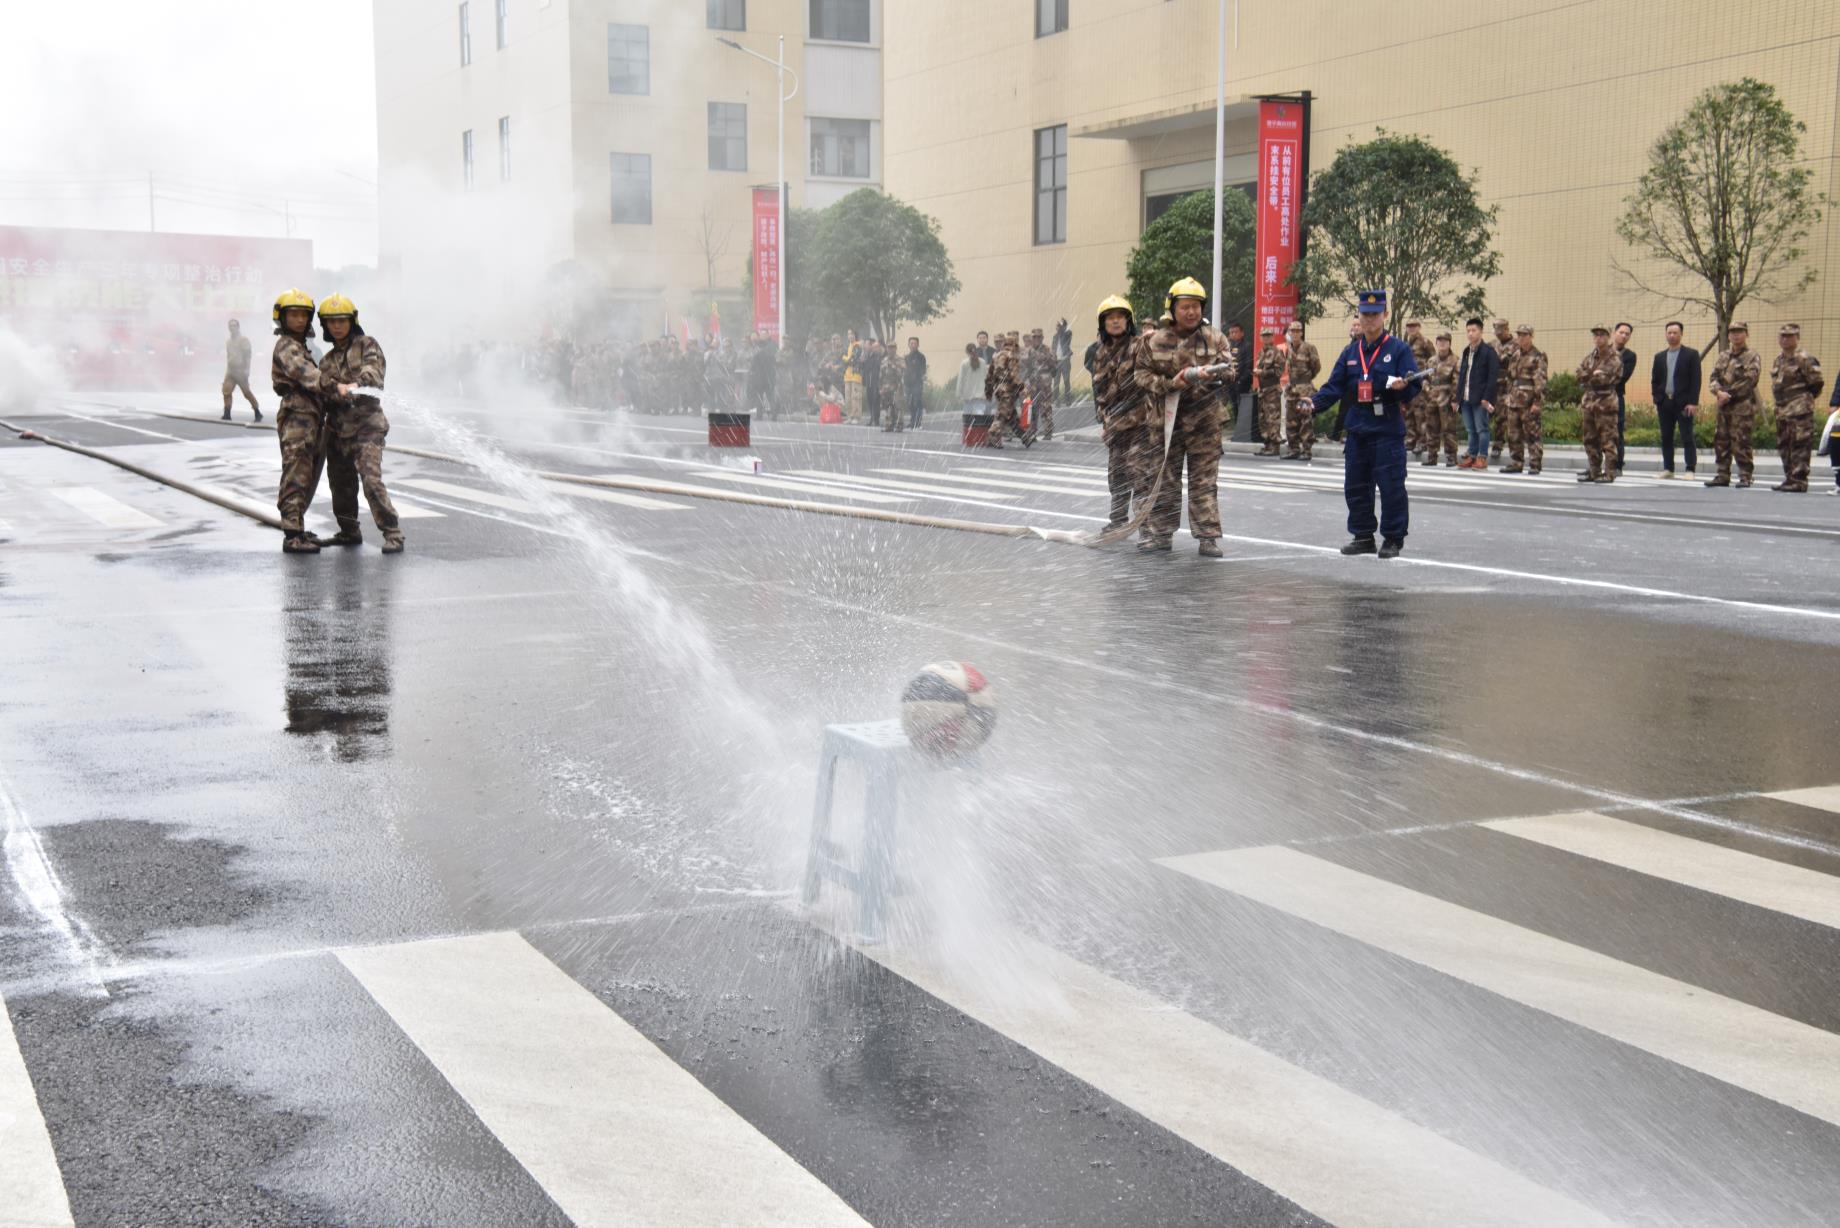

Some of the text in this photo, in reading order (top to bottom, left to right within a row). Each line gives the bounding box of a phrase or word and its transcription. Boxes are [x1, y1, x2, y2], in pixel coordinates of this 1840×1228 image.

[0, 257, 264, 284] 安全生产三年专项整治行动
